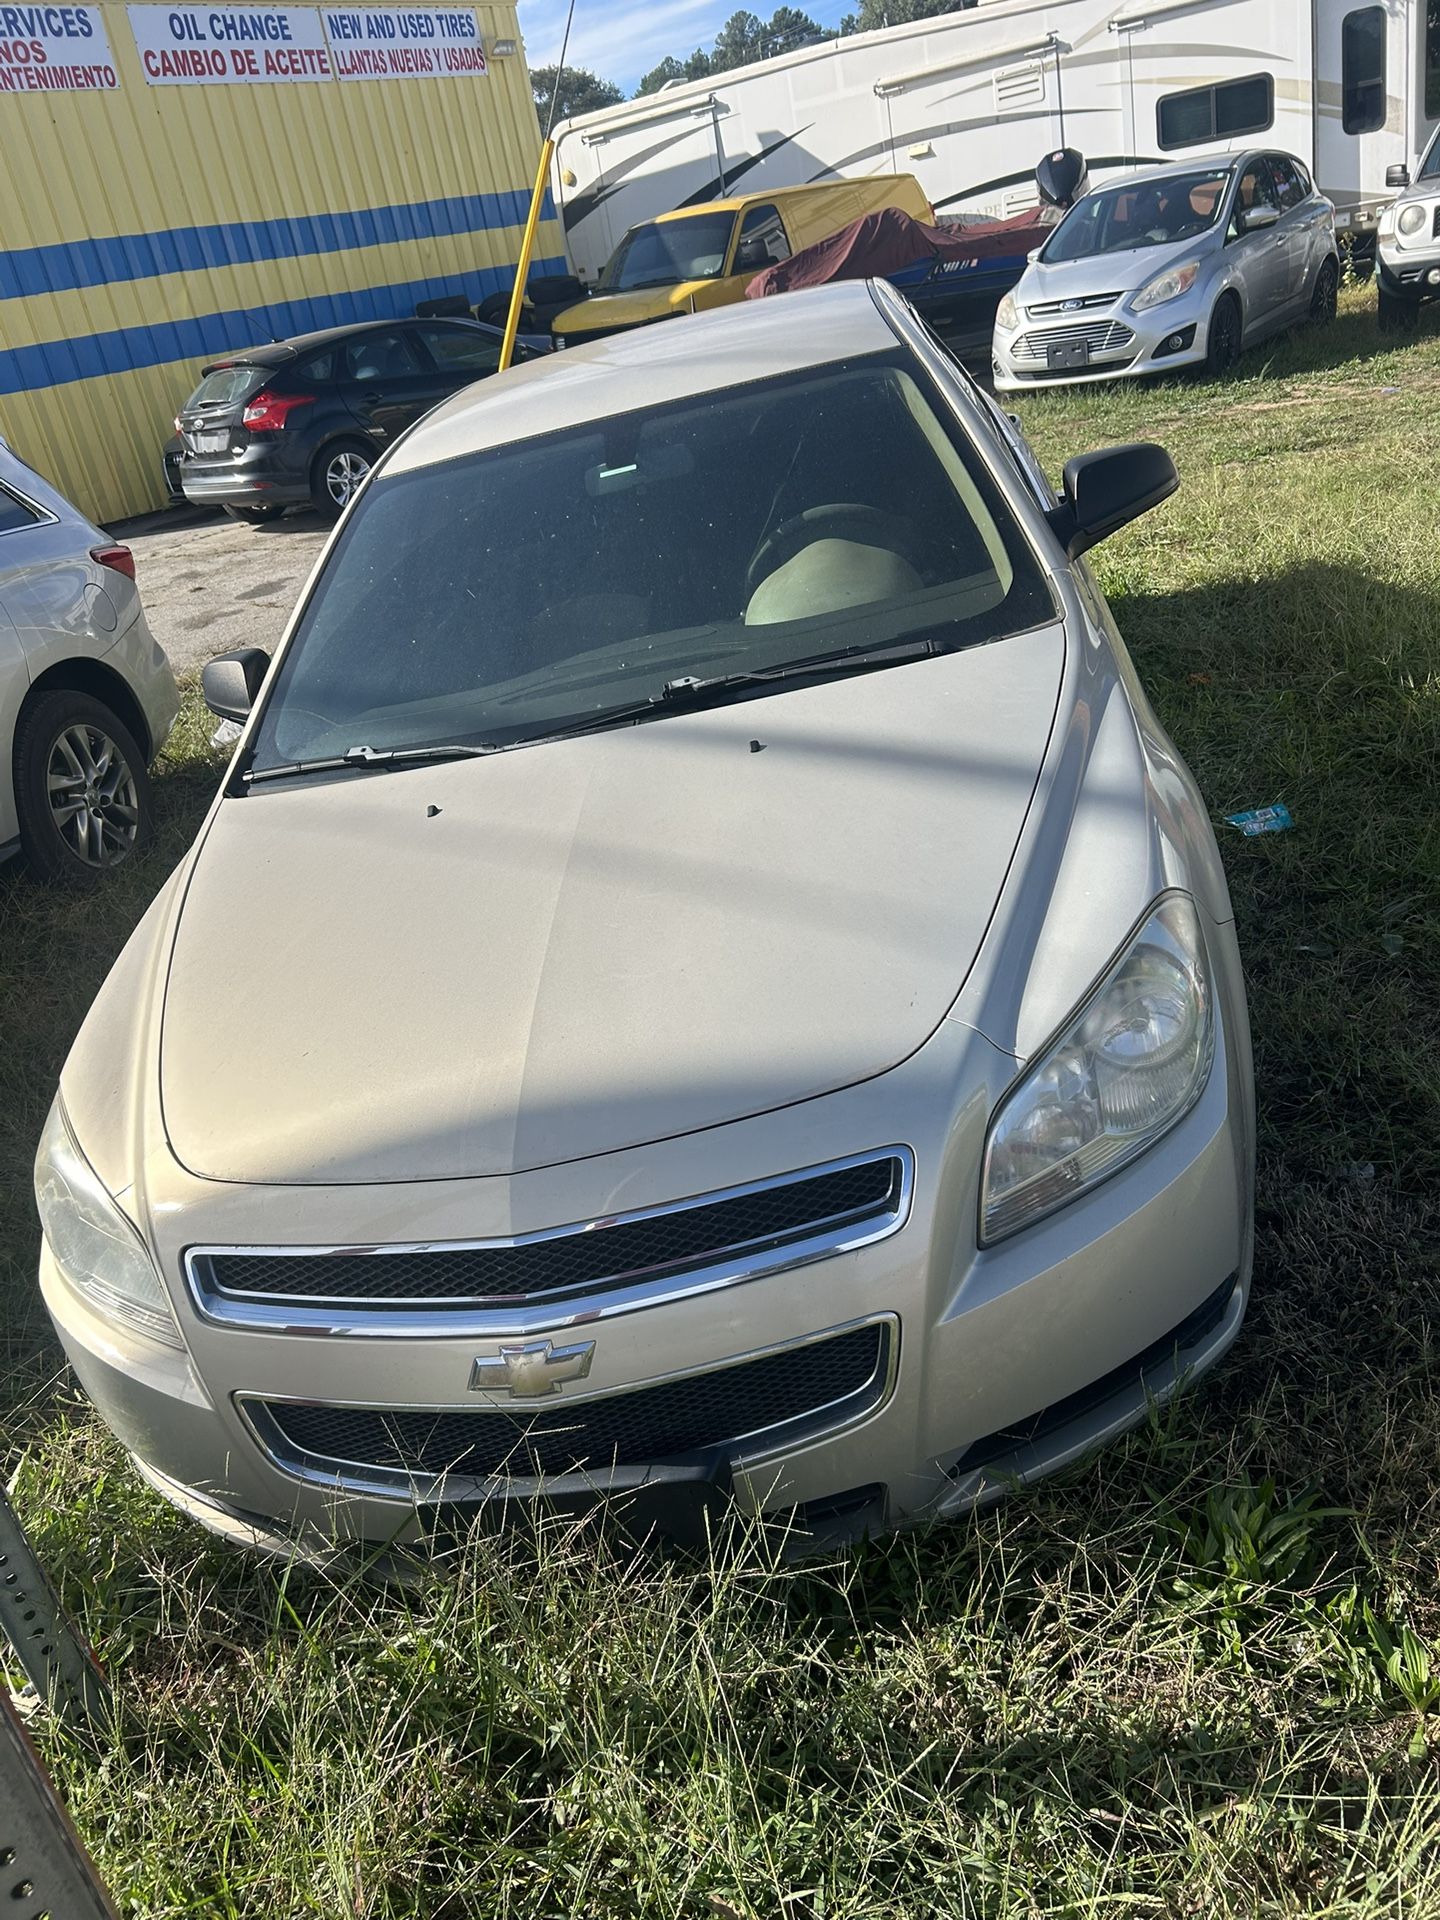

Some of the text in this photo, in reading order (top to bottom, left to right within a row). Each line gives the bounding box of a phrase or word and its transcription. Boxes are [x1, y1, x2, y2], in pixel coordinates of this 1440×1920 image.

[168, 13, 292, 40] OIL CHANGE
[327, 14, 475, 39] NEW AND USED TIRES
[143, 49, 331, 77] CAMBIO DE ACEITE
[334, 47, 485, 75] LLANTAS NUEVAS Y USADAS
[0, 65, 116, 91] NTENIMIENTO
